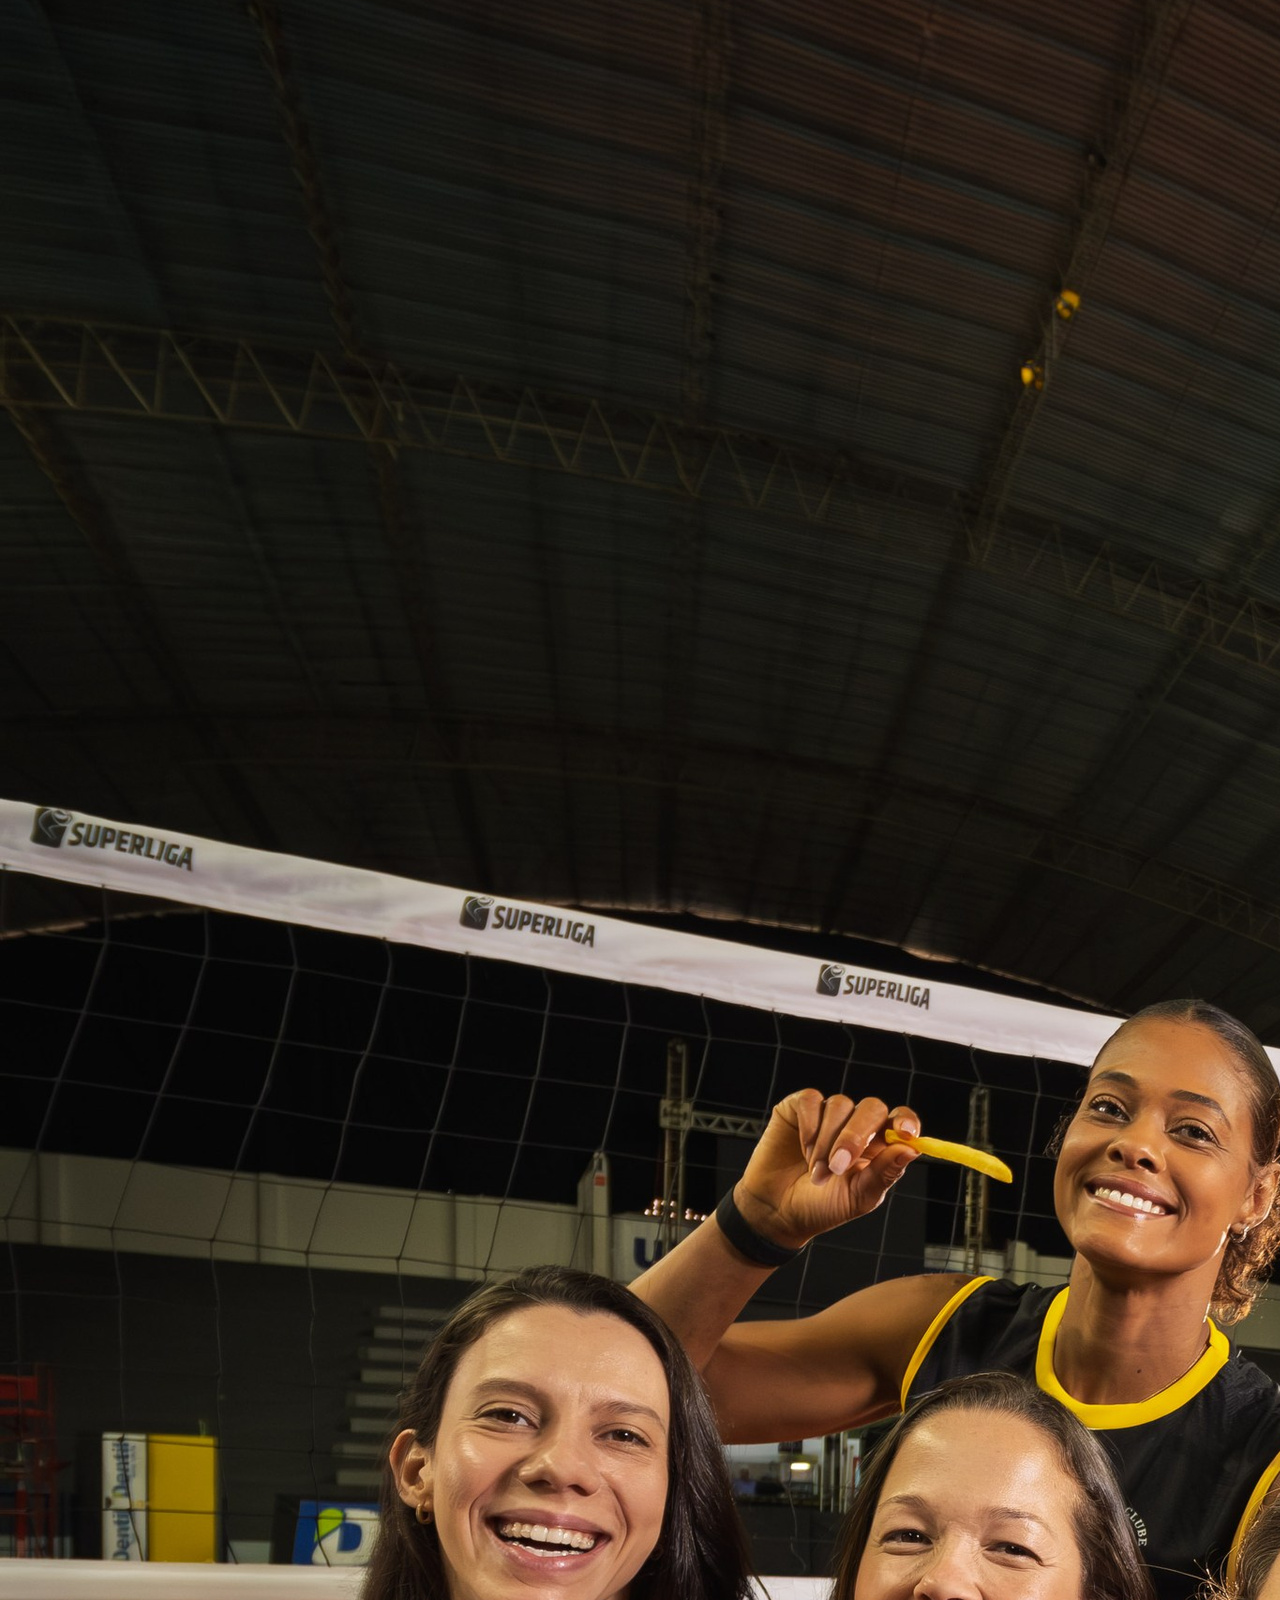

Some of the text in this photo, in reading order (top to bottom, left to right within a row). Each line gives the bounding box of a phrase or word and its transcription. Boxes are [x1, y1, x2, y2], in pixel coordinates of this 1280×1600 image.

[69, 821, 194, 871] SUPERLIGA
[492, 905, 595, 948] SUPERLIGA
[843, 974, 930, 1011] SUPERLIGA
[1125, 1506, 1148, 1547] CLUBE
